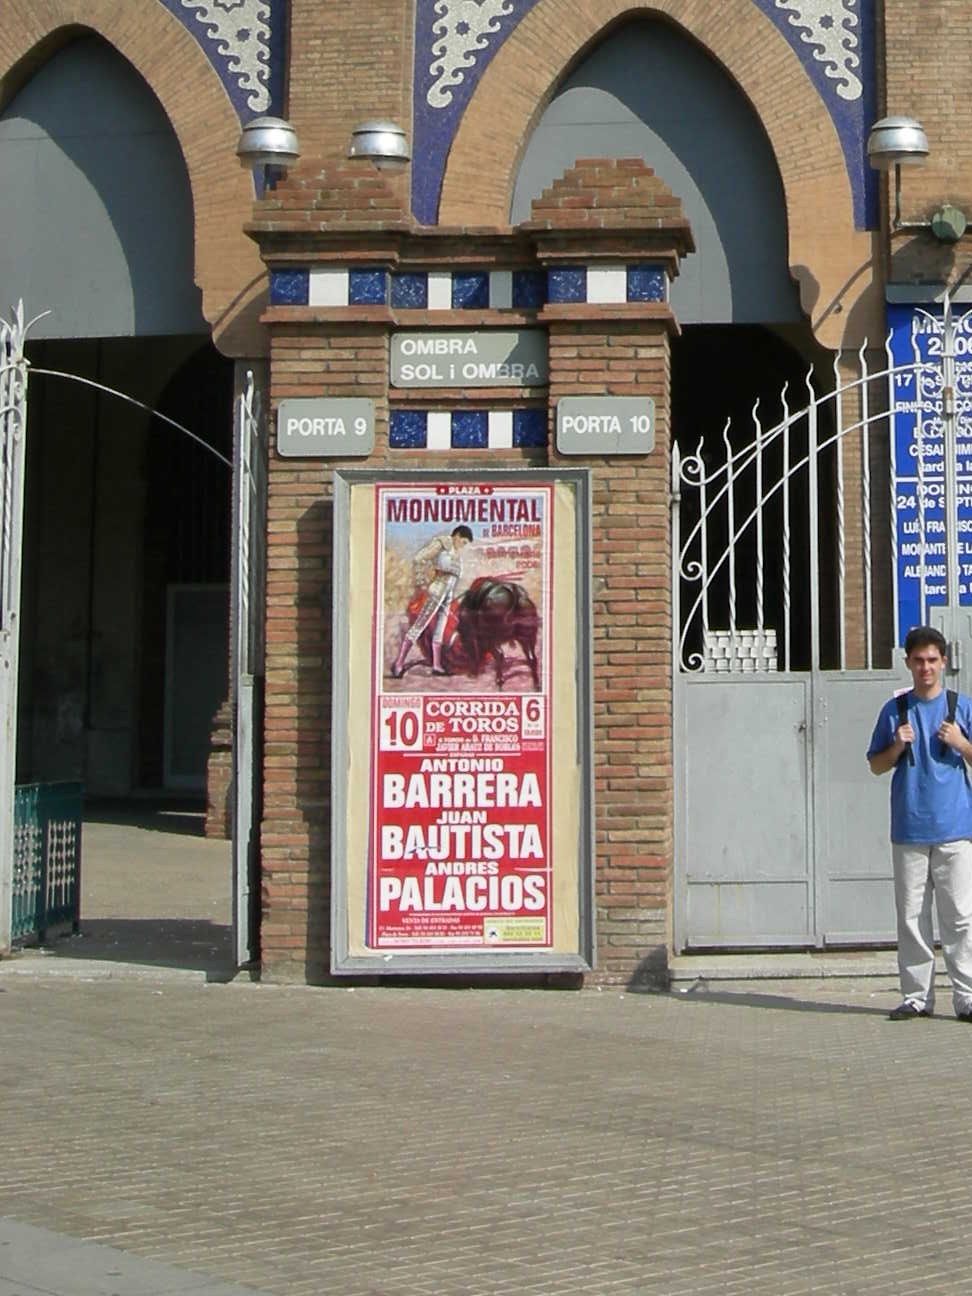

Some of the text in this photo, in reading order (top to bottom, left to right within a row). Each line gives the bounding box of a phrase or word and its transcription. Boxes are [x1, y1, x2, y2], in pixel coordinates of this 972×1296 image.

[401, 339, 477, 355] OMBRA
[401, 362, 539, 381] SOL i OMBRA
[895, 374, 912, 387] 17
[896, 401, 933, 414] FINIO
[287, 418, 367, 436] PORTA 9
[562, 415, 650, 434] PORTA 10
[909, 441, 948, 456] CÉSA
[921, 460, 951, 472] tard
[447, 485, 481, 496] PLAZA
[897, 496, 917, 509] 24
[386, 499, 542, 523] MONUMENTAL
[491, 524, 541, 538] BARCELONA
[903, 517, 924, 534] LUÍ
[904, 563, 960, 579] ALEANDO
[924, 584, 954, 595] tard
[425, 701, 520, 718] CORRIDA
[526, 698, 541, 722] 6
[384, 711, 420, 746] 10
[425, 717, 519, 734] DE TOROS
[420, 758, 505, 773] ANTONIO
[383, 773, 543, 809] BARRERA
[436, 811, 487, 825] JUAN
[381, 824, 544, 861] BAUTISTA
[425, 862, 500, 876] ANDRES
[379, 875, 547, 912] PALACIOS
